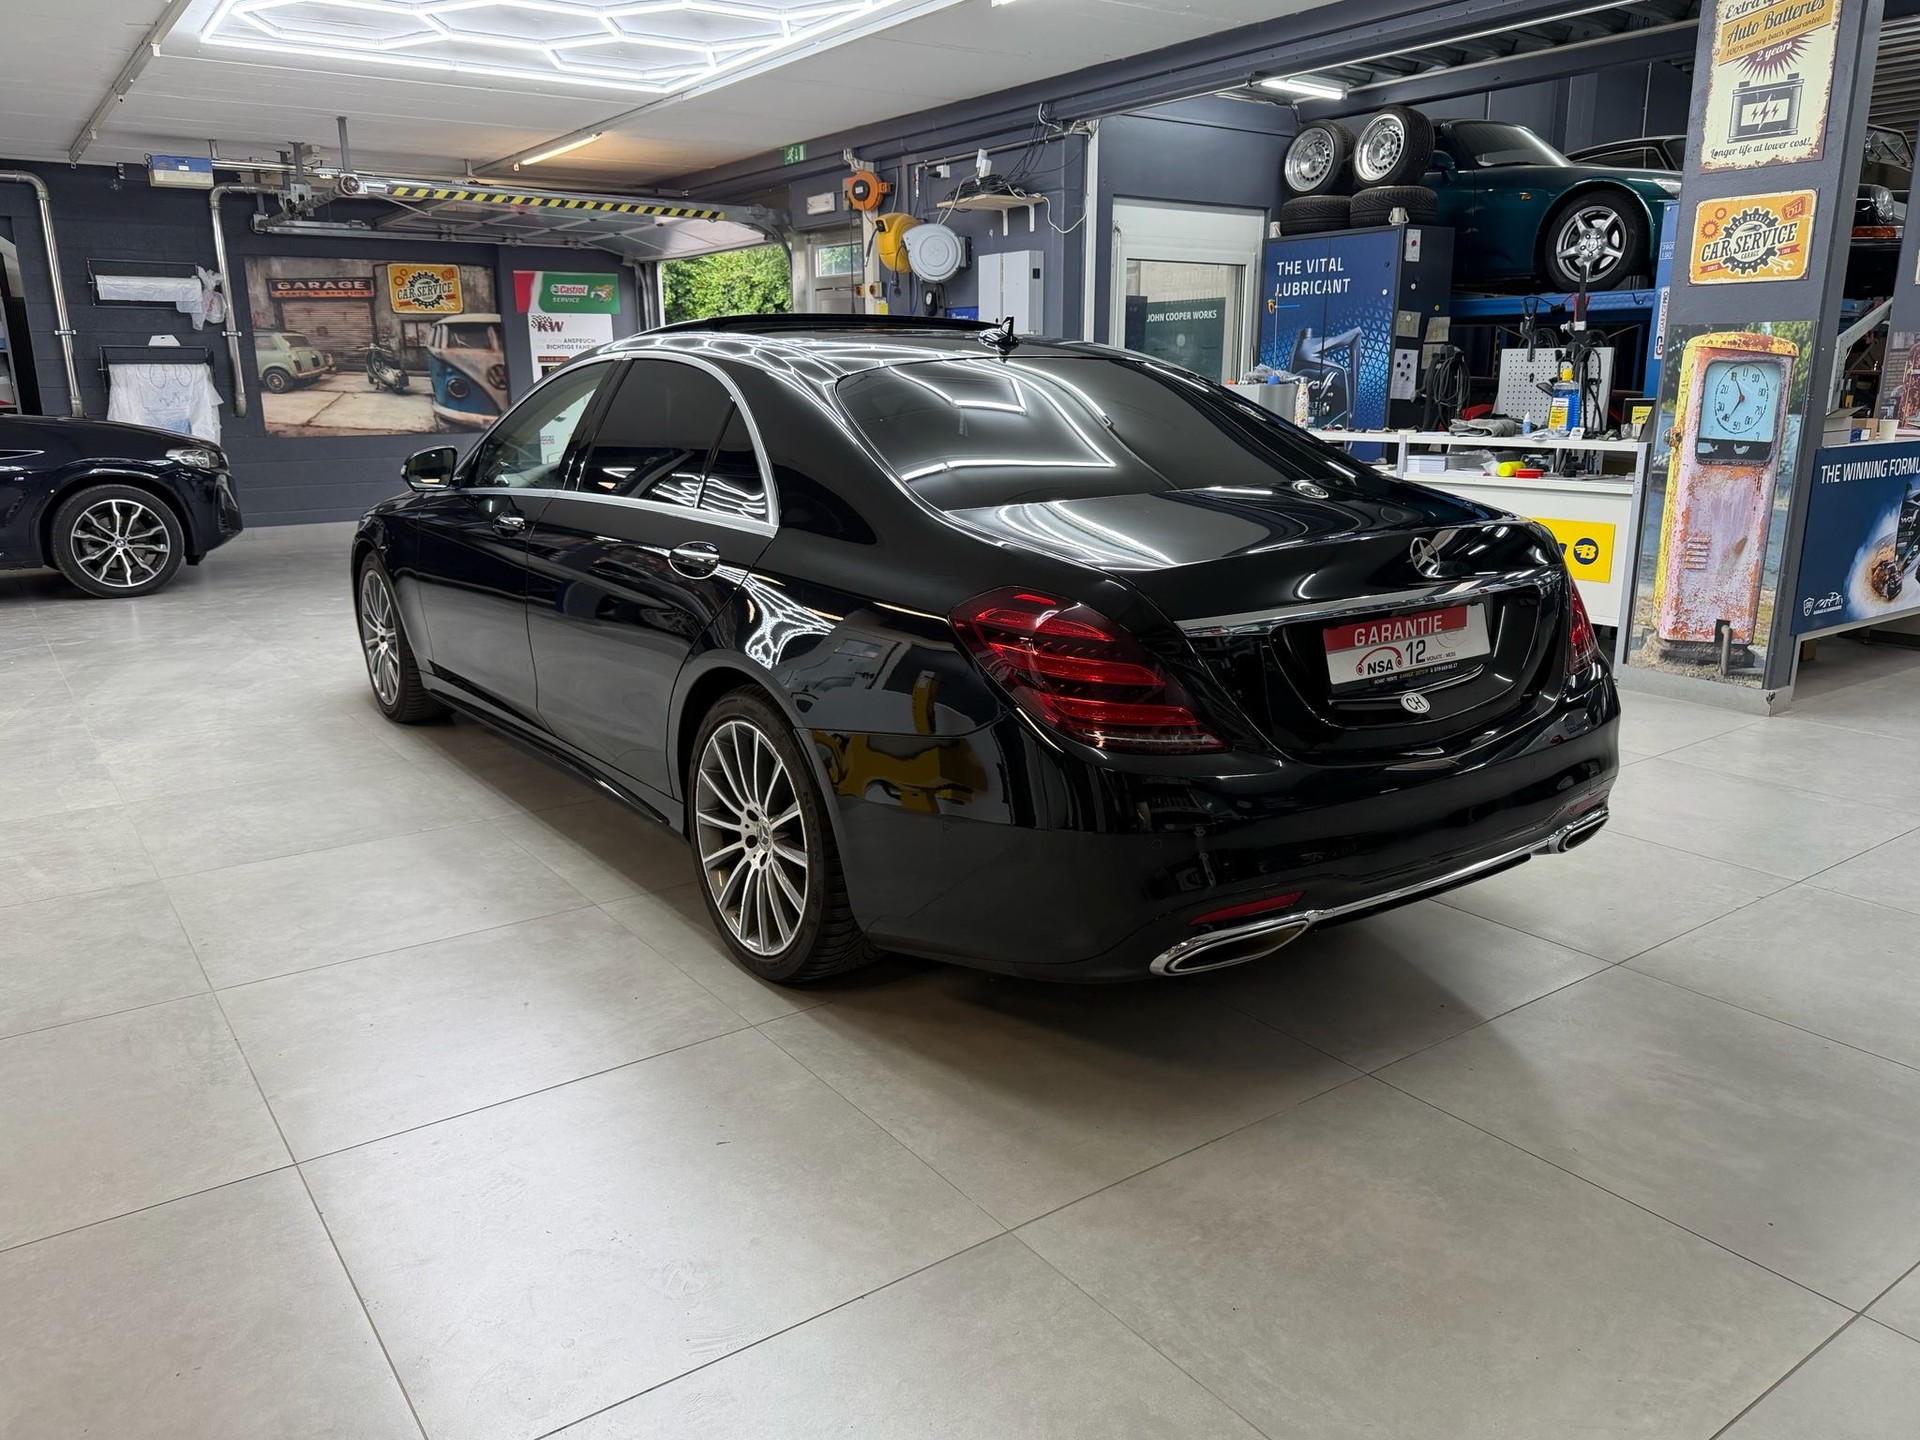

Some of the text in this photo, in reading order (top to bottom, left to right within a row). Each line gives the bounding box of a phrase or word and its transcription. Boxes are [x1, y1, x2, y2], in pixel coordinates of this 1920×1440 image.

[1727, 0, 1826, 47] Auto Batteries
[1726, 45, 1744, 57] 100%
[1744, 36, 1768, 50] money
[1767, 29, 1785, 41] back
[1756, 41, 1794, 62] 2 years
[1710, 136, 1811, 160] Longer life at lower cost!
[1701, 222, 1798, 262] CAR SERVICE
[1276, 256, 1344, 276] THE VITAL
[277, 281, 366, 290] GARAGE
[397, 282, 453, 300] CAR SERVICE
[559, 284, 586, 295] Castrol
[1276, 277, 1351, 298] LUBRICANT
[1146, 309, 1217, 323] JOHN COOPER WORKS
[1752, 373, 1760, 383] 90
[1720, 384, 1729, 394] 20
[1717, 401, 1725, 412] 30
[1754, 405, 1763, 415] 70
[1733, 421, 1741, 431] 50
[1820, 463, 1842, 485] THE
[1842, 459, 1888, 482] WINNING
[1354, 614, 1443, 647] GARANTIE
[1405, 639, 1427, 666] 12
[1367, 658, 1394, 676] NSA
[1405, 695, 1426, 712] CH
